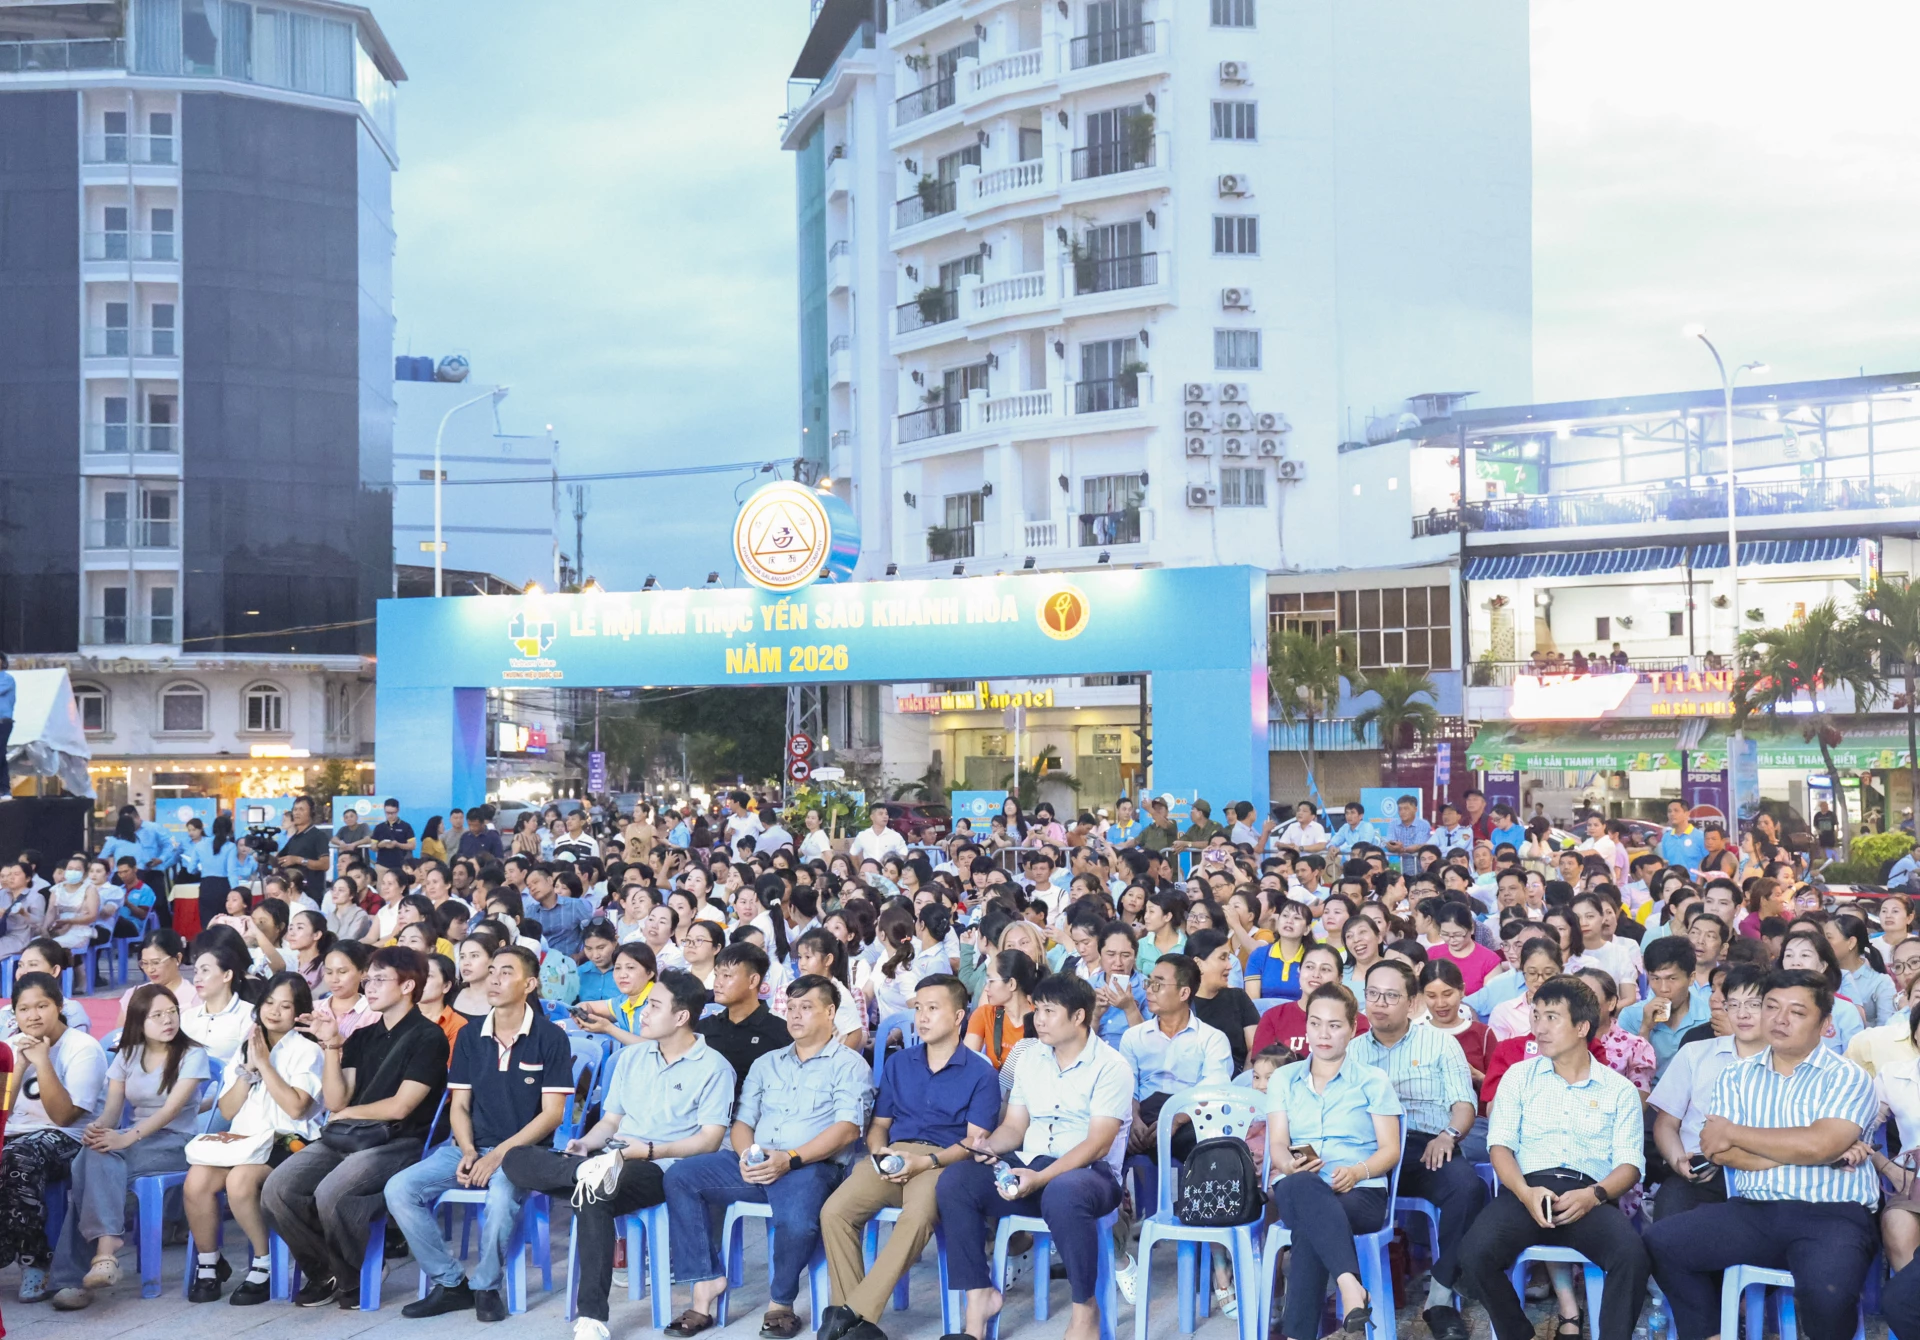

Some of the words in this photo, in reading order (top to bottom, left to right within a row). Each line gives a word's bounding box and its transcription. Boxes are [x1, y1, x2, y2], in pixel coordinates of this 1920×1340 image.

[808, 540, 823, 567] COMPANY
[760, 596, 808, 631] YẾN
[158, 656, 174, 673] 2
[725, 642, 782, 674] NĂM
[789, 644, 848, 673] 2026
[1651, 699, 1671, 715] HẢI
[1673, 697, 1697, 715] SẢN
[1527, 755, 1542, 767] HẢI
[1544, 754, 1562, 767] SẢN
[1564, 756, 1594, 767] THANH
[1775, 752, 1795, 765] SẢN
[1798, 754, 1826, 765] THAN
[1688, 774, 1721, 782] PEPSI
